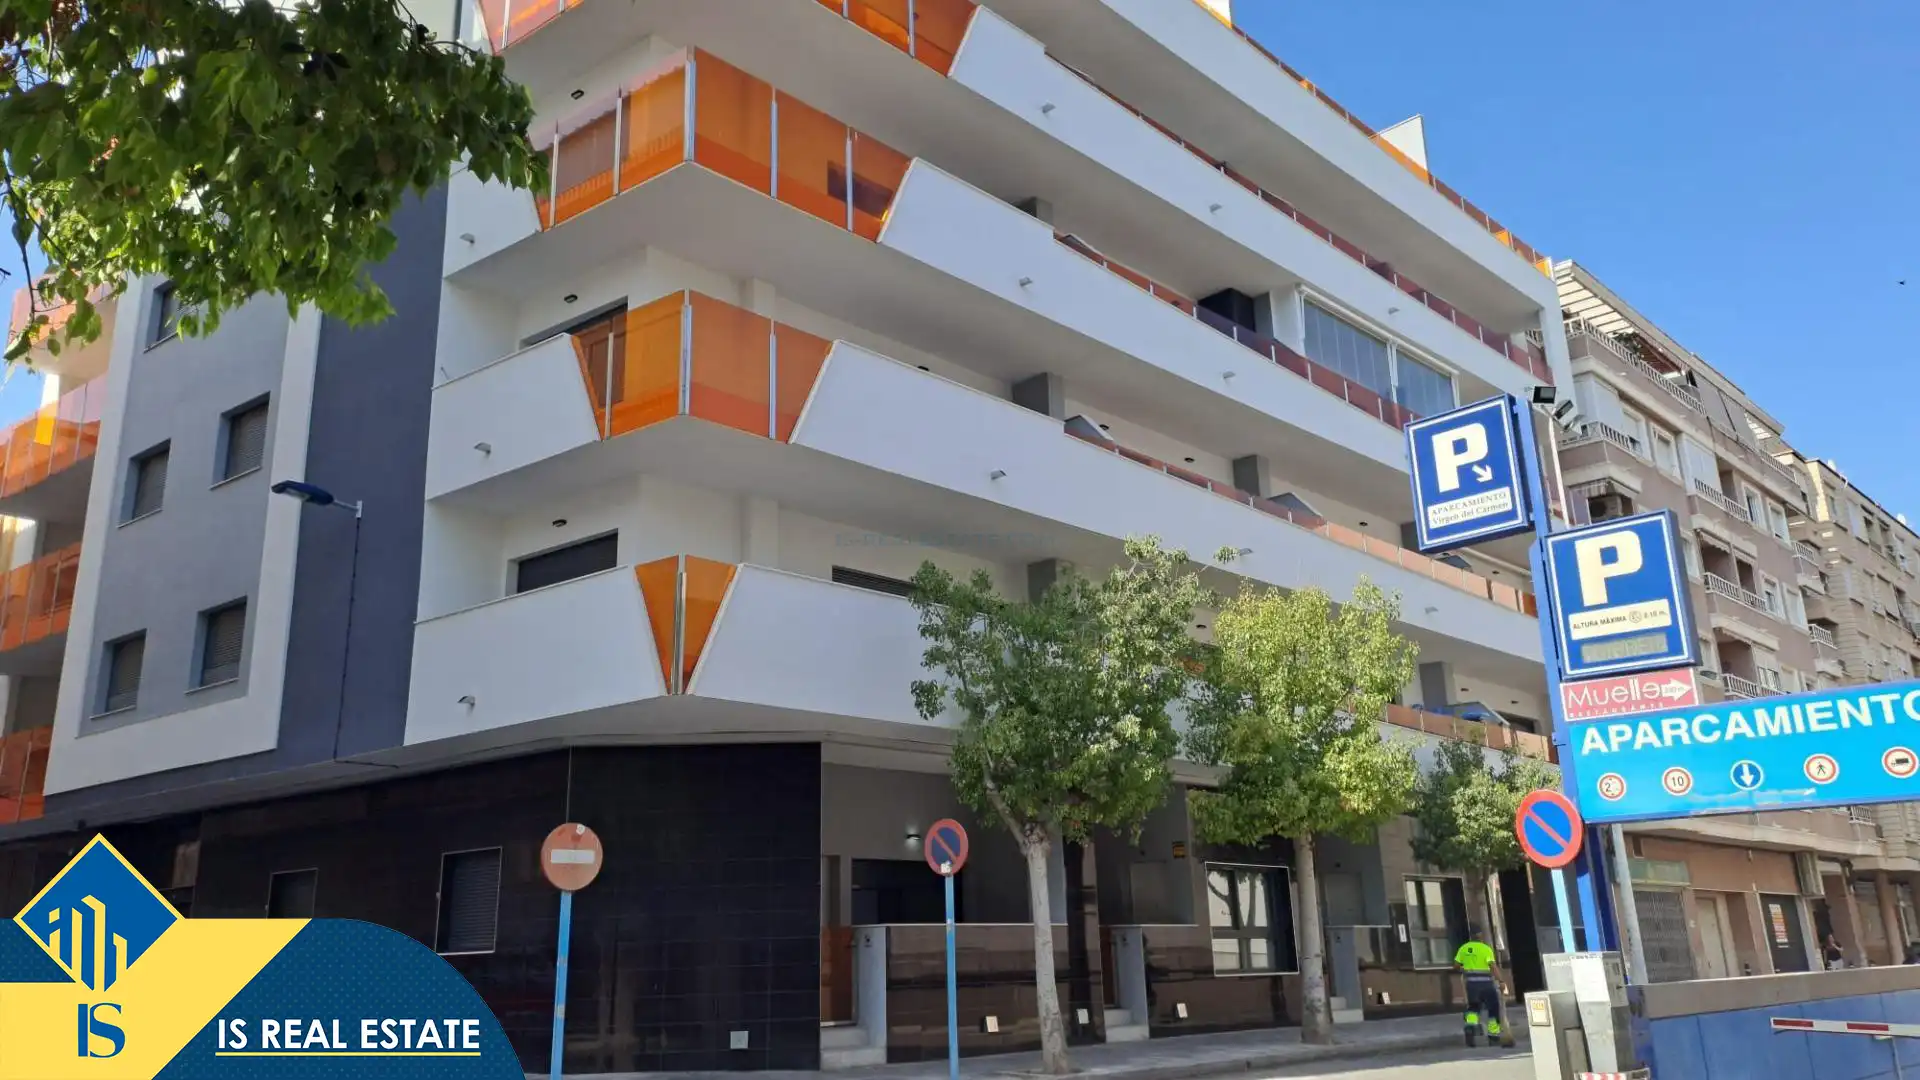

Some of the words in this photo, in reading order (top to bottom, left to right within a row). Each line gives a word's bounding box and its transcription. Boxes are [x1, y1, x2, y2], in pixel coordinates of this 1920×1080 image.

[1431, 422, 1489, 493] P
[1431, 491, 1507, 515] APARCAMIENTO
[1433, 511, 1459, 526] Virgen
[1461, 508, 1475, 519] del
[1475, 501, 1509, 514] Carmen
[1574, 530, 1643, 607] P
[1572, 619, 1599, 630] ALTURA
[1581, 689, 1920, 756] APARCAMIENTO
[1671, 775, 1685, 788] 10
